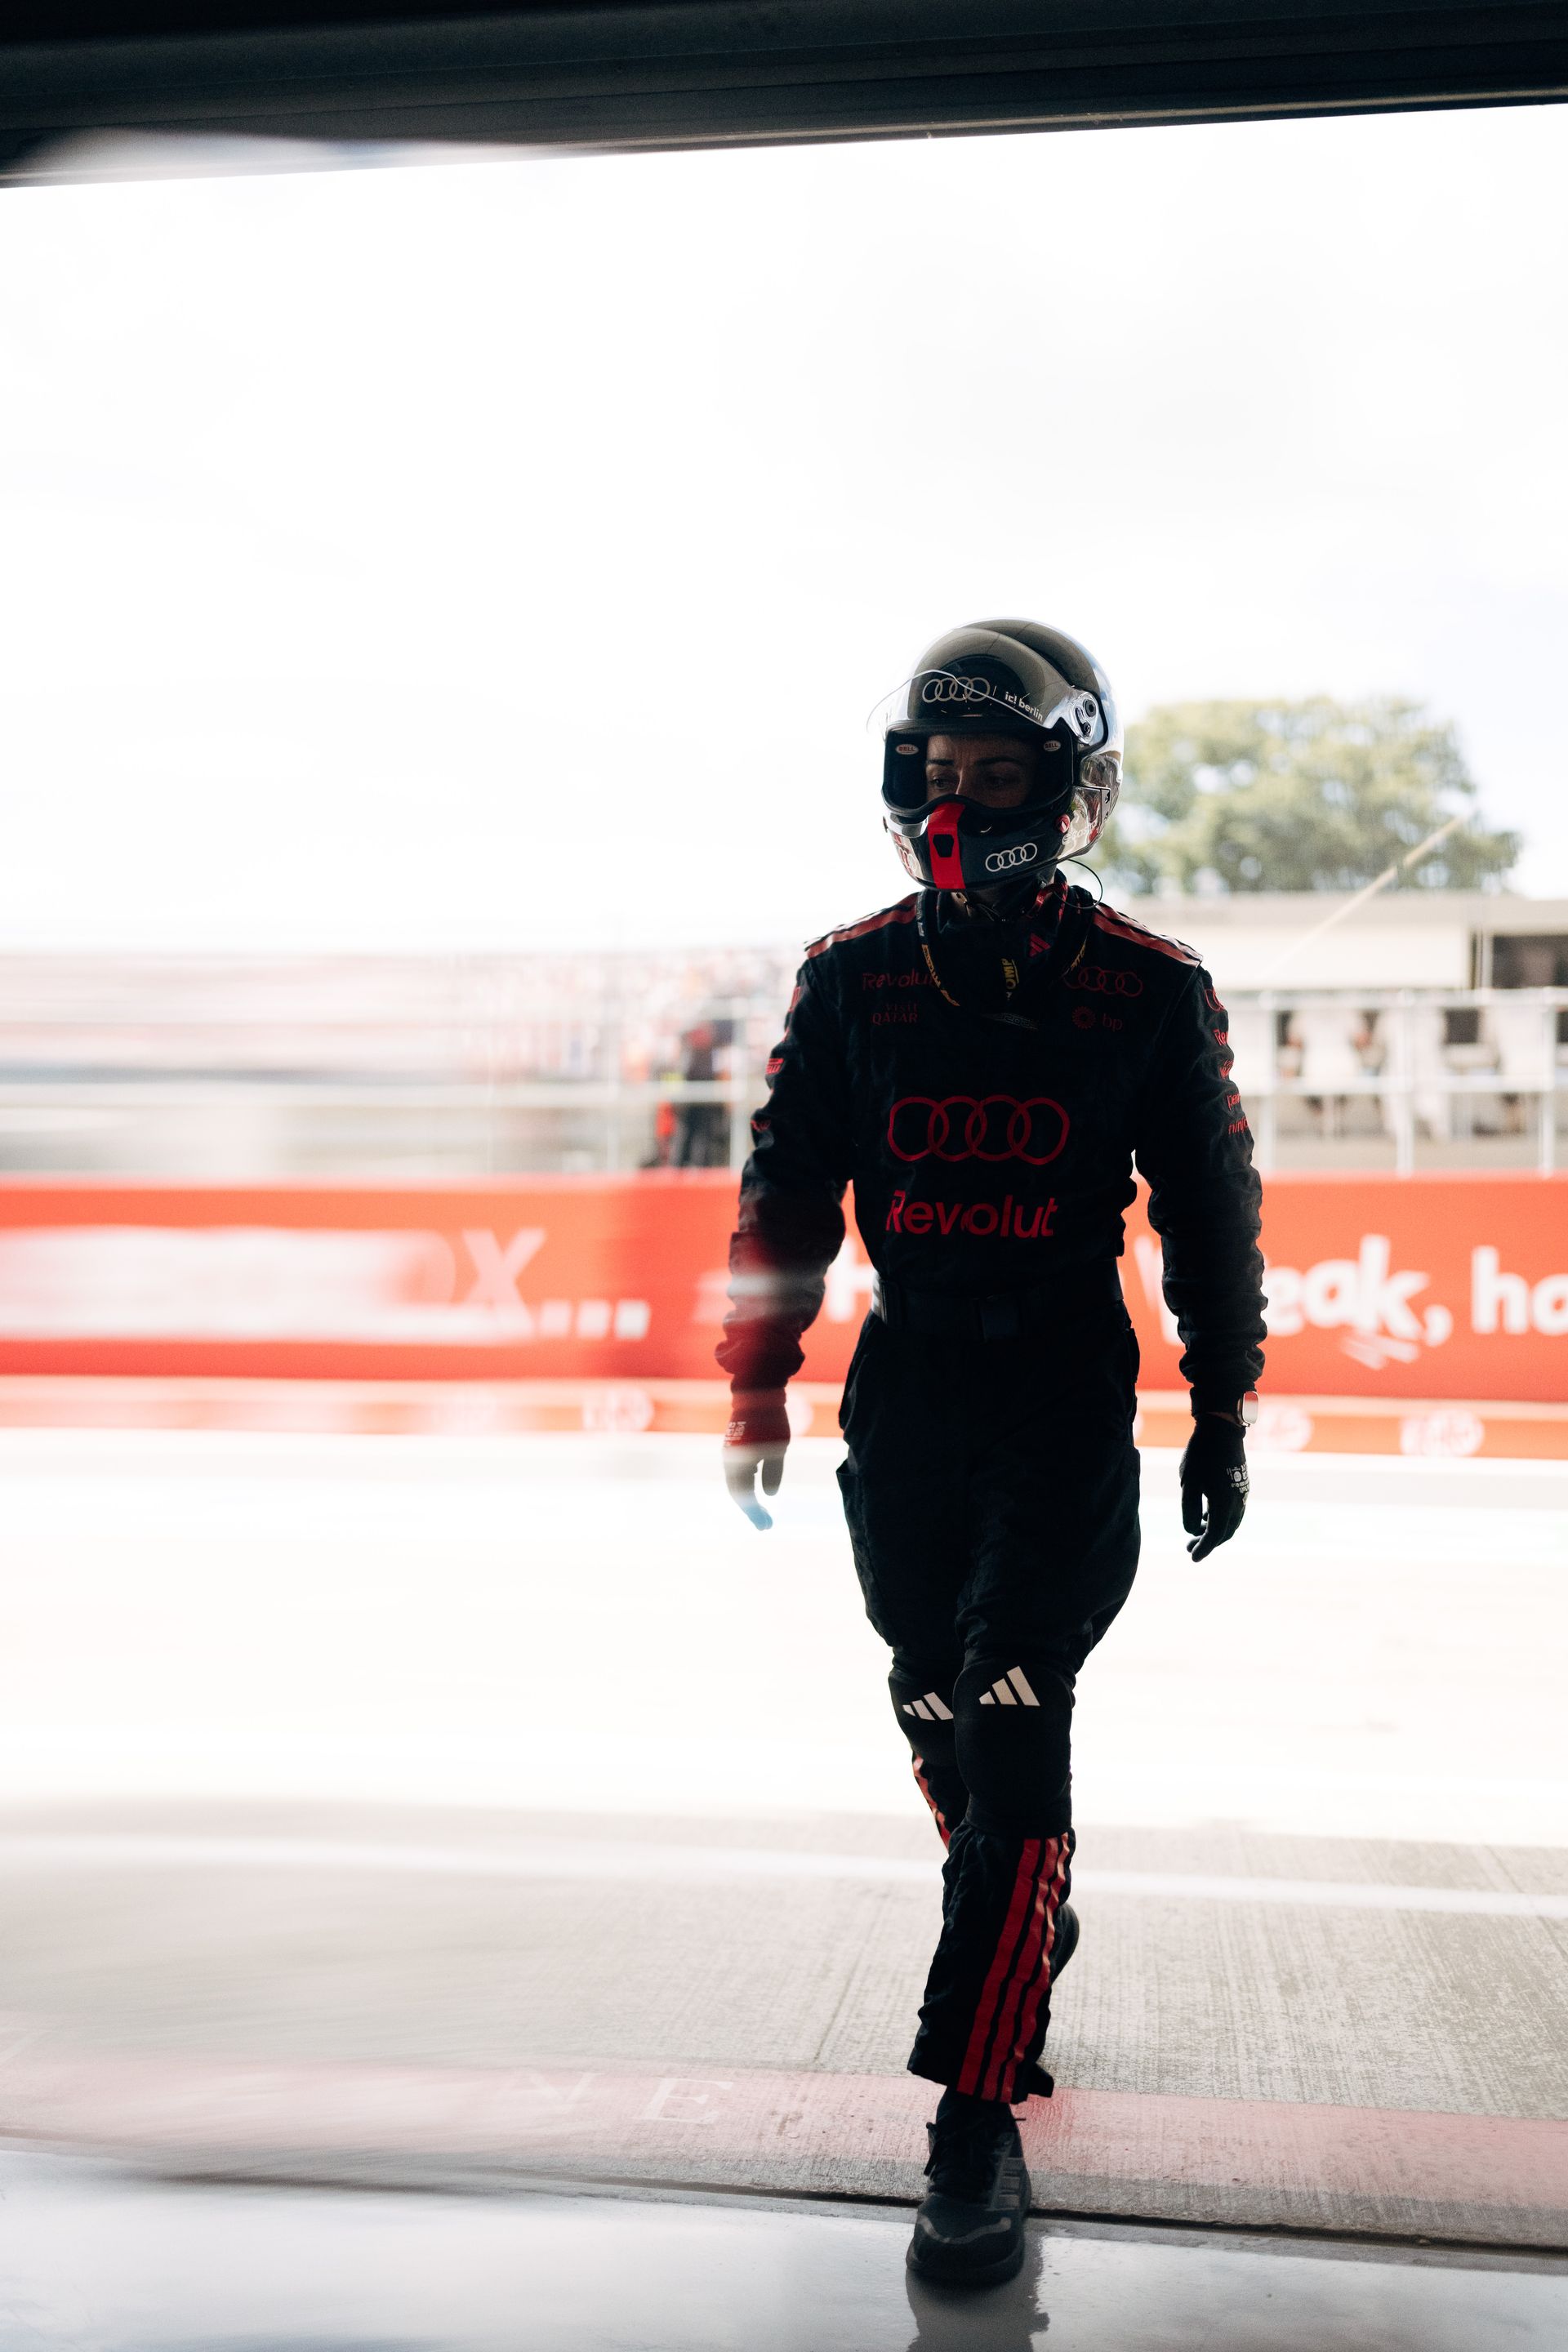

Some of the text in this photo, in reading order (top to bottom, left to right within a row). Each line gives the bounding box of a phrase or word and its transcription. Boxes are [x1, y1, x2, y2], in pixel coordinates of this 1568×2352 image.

[1018, 697, 1044, 722] berlin
[862, 968, 934, 992] Revolu
[1000, 957, 1018, 991] OMP
[871, 1011, 920, 1027] QATAR
[1102, 1012, 1125, 1032] bp
[884, 1190, 1059, 1240] Revolut
